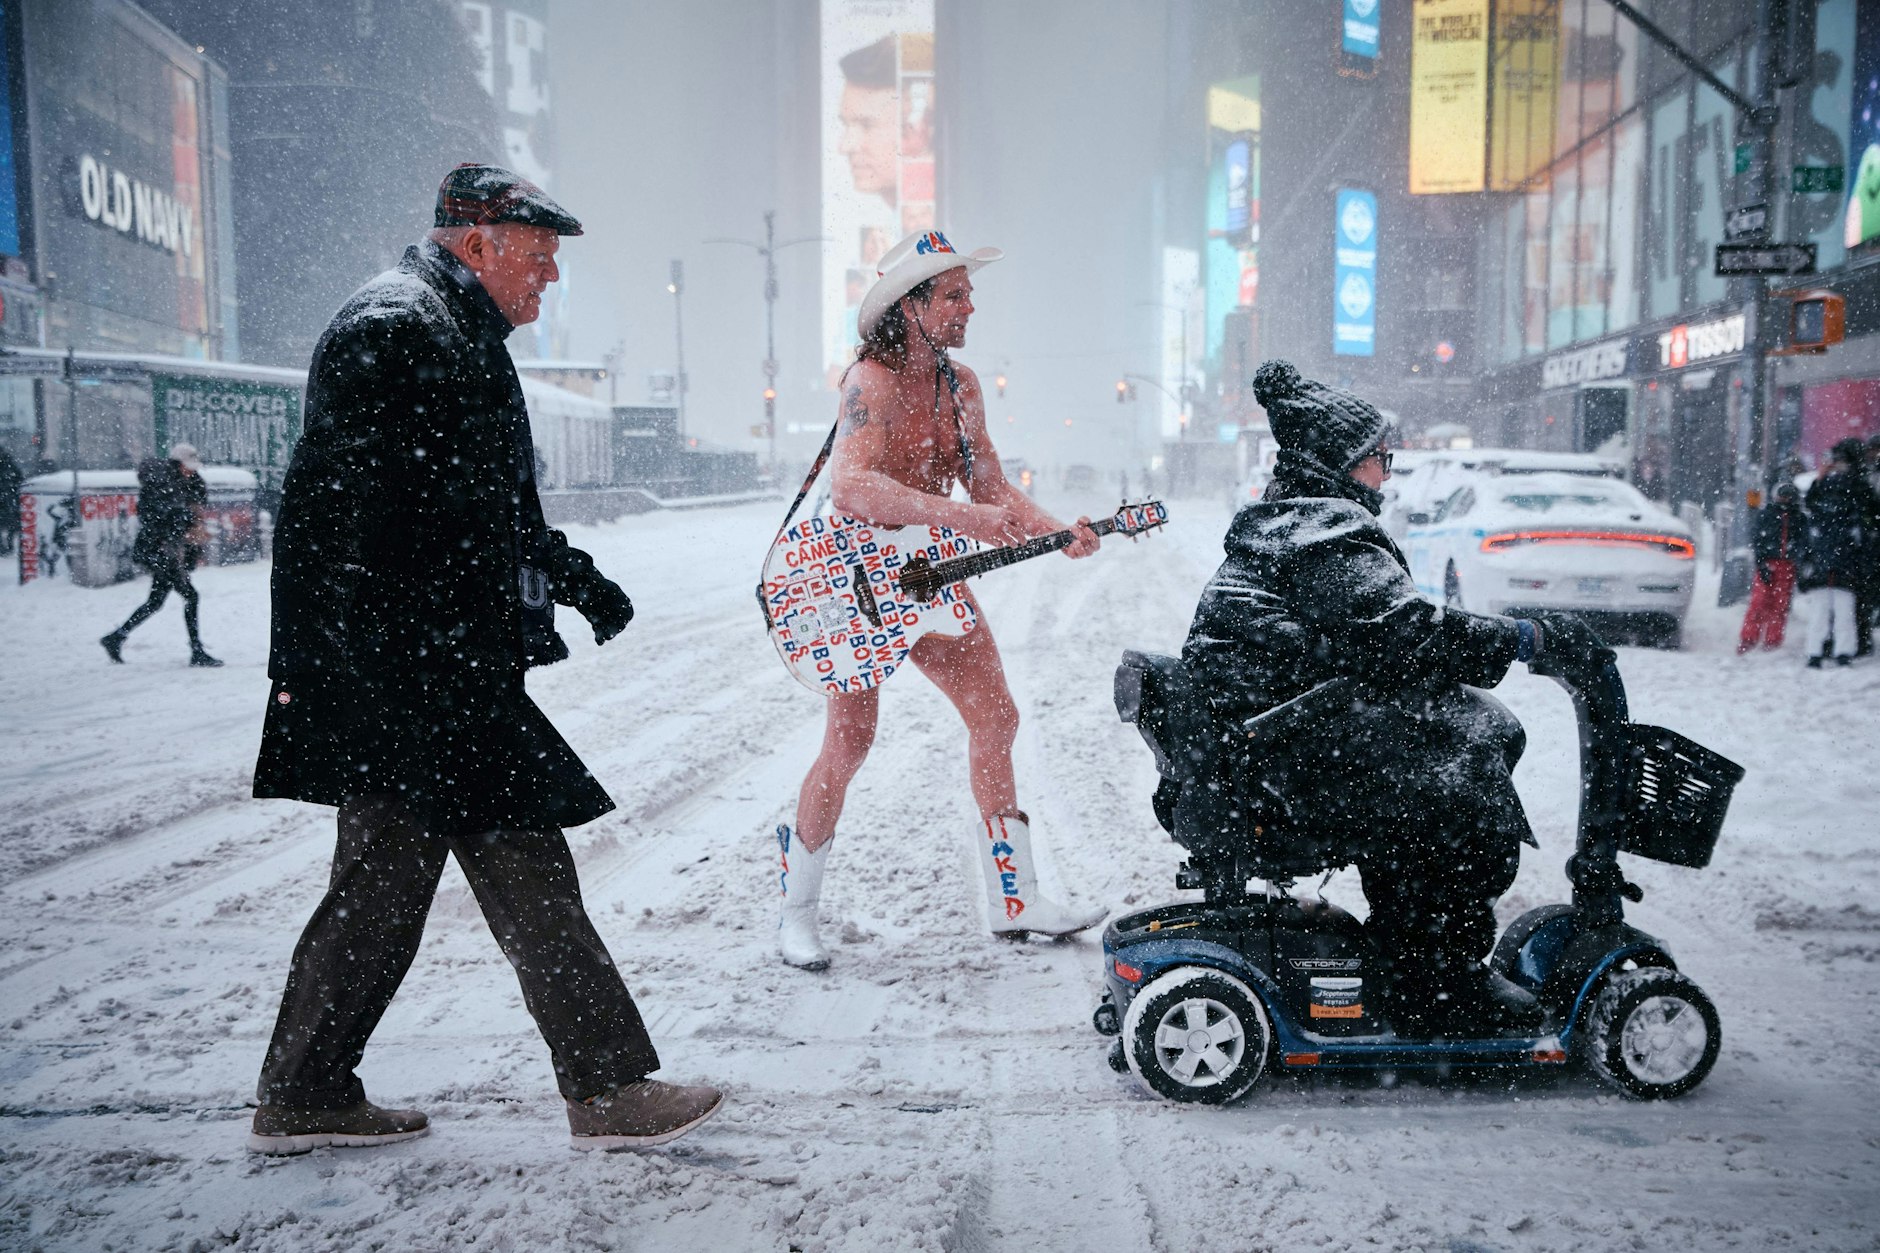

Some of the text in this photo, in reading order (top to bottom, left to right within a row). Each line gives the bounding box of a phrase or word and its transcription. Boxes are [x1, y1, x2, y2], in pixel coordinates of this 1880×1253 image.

[81, 154, 192, 257] OLD NAVY
[1688, 314, 1746, 361] TISSOT
[1542, 337, 1629, 390] SKECHERS
[166, 389, 286, 415] DISCOVER
[1114, 503, 1167, 530] NAKED
[856, 524, 890, 597] COWBO
[879, 543, 919, 628] OYSTERS
[1321, 990, 1359, 998] Scootaround
